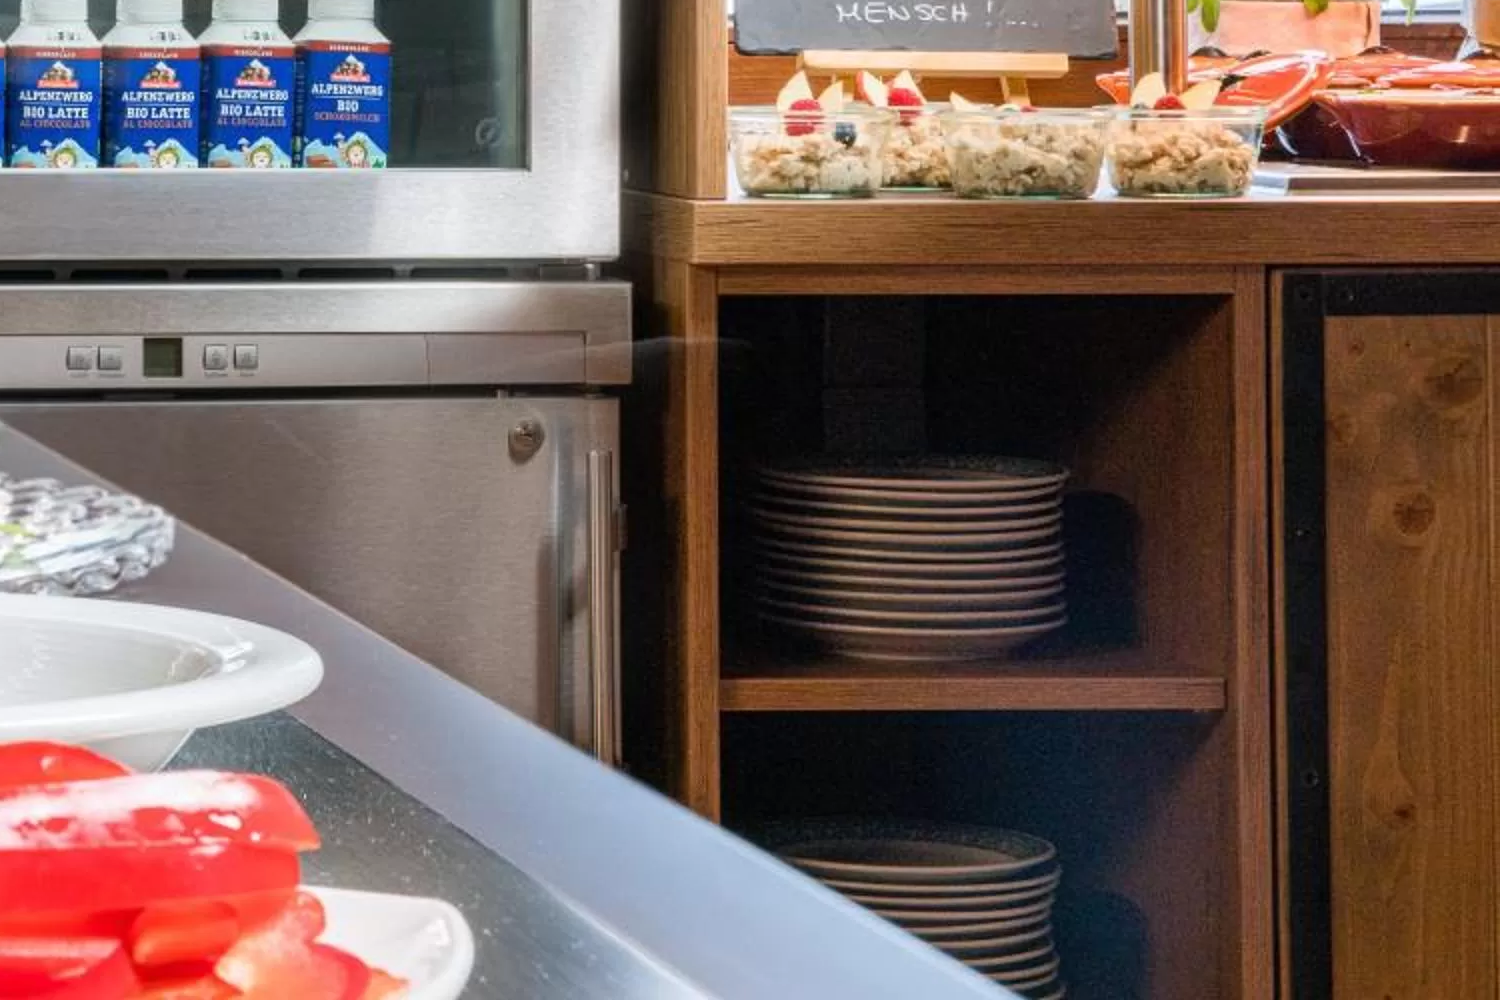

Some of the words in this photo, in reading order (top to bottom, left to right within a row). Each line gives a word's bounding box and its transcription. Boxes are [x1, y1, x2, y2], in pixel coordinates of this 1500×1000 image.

[19, 90, 93, 103] ALPENZWERG
[122, 91, 195, 102] ALPENZWERG
[216, 88, 289, 101] ALPENZWERG
[311, 83, 384, 97] ALPENZWERG
[23, 106, 46, 118] BIO
[48, 107, 89, 119] LATTE
[220, 104, 243, 117] BIO
[245, 105, 285, 117] LATTE
[337, 100, 359, 112] BIO
[127, 107, 149, 119] BIO
[152, 107, 190, 119] LATTE
